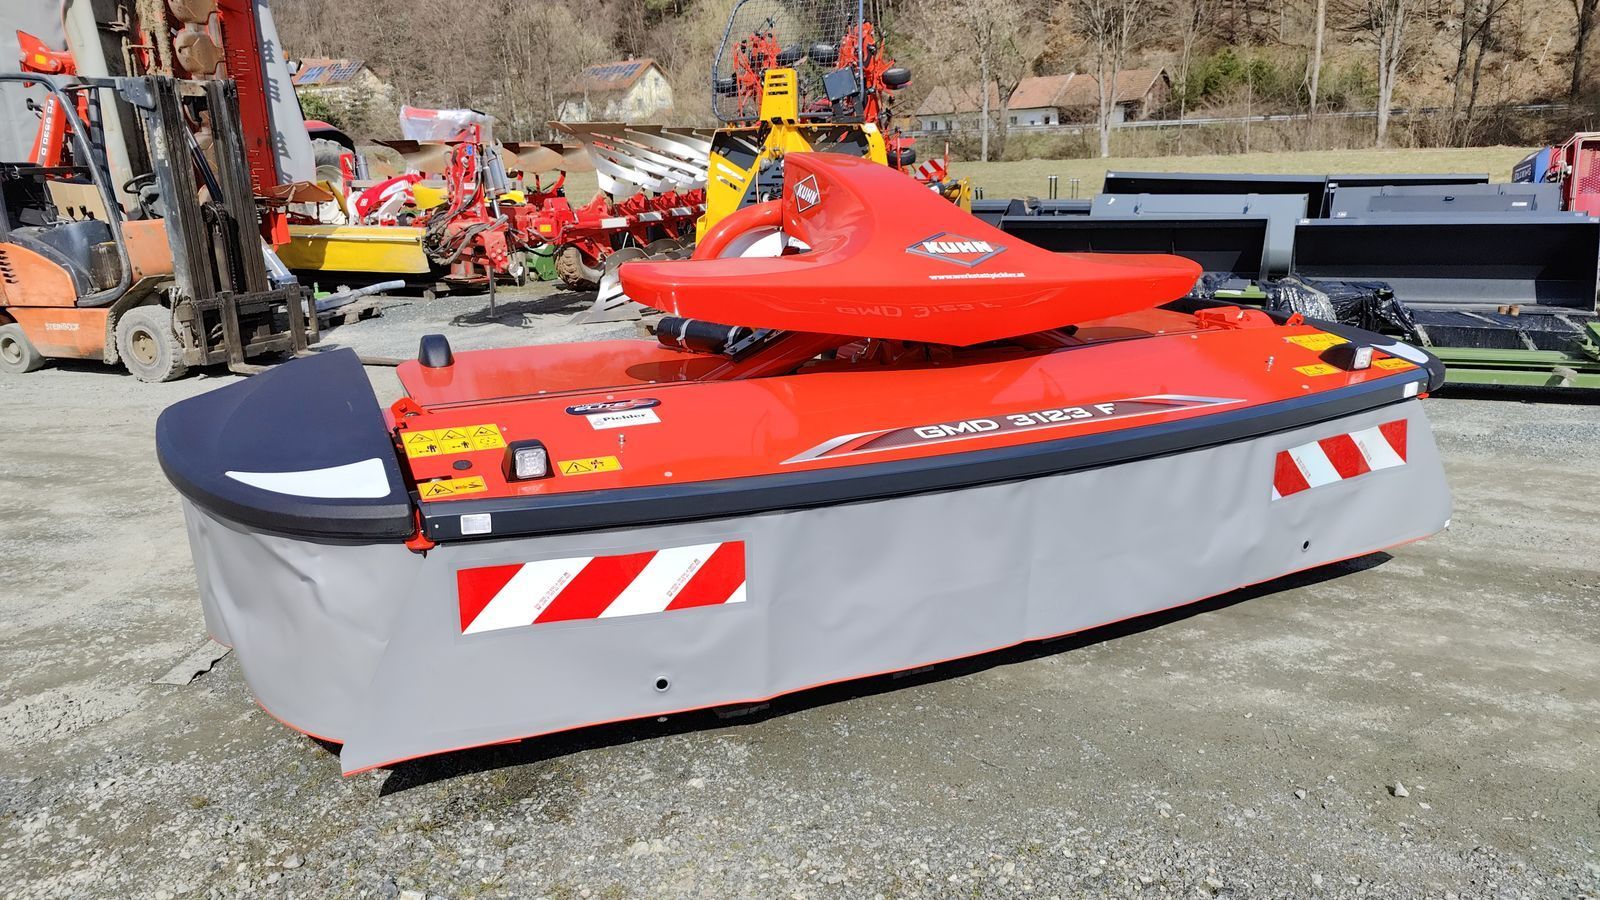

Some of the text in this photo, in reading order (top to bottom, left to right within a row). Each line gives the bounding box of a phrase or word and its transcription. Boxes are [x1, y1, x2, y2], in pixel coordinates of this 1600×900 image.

[47, 99, 54, 114] FC
[42, 117, 52, 145] 9530
[796, 183, 818, 206] KUHN
[922, 241, 994, 254] KUHN
[602, 413, 646, 422] Pichler
[913, 403, 1116, 439] GMD 3123 F
